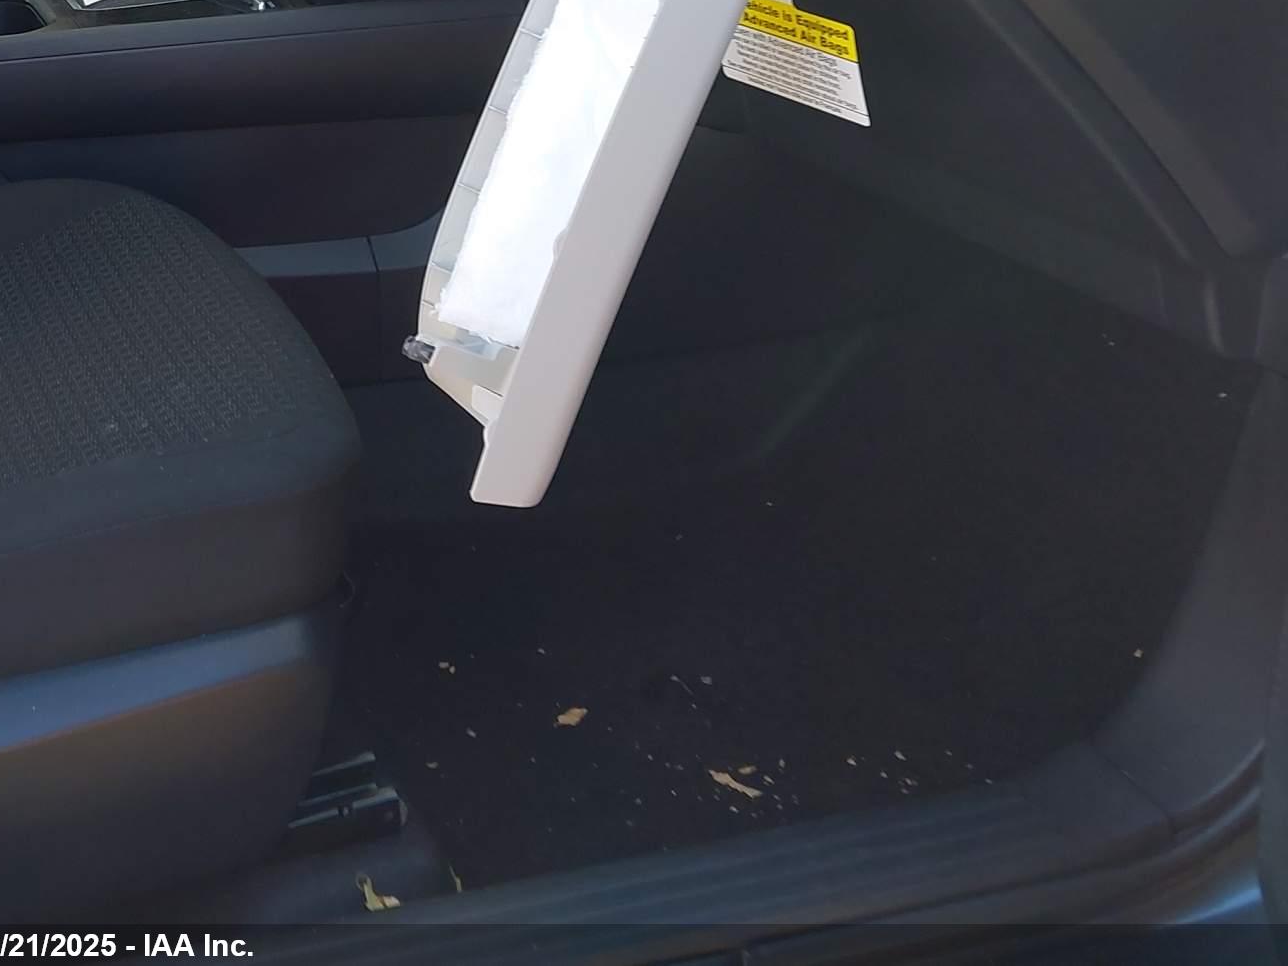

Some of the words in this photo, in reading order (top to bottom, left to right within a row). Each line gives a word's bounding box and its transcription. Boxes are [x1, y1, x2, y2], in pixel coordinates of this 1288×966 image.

[744, 12, 797, 38] Advanced
[800, 30, 817, 45] Air
[821, 35, 850, 56] Bags
[746, 0, 780, 19] ehicle
[782, 10, 793, 23] is
[796, 15, 849, 41] Equipped
